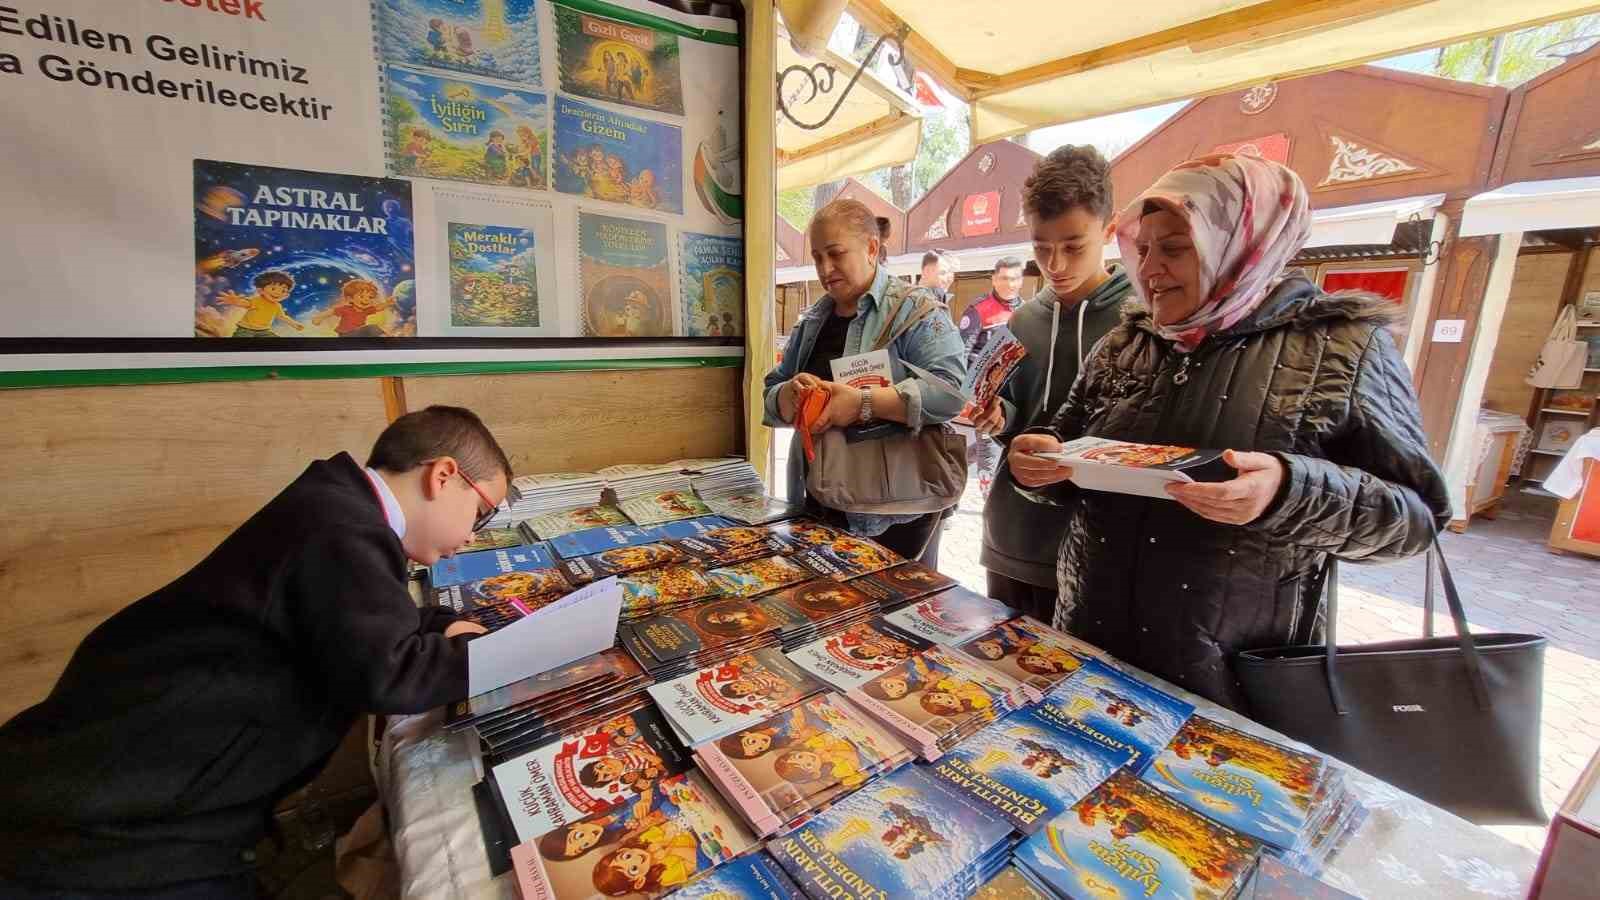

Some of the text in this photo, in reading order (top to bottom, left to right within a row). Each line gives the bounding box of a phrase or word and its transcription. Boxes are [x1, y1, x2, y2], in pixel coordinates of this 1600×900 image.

[0, 6, 309, 85] Edilen Gelirimiz
[38, 53, 334, 121] Gönderilecektir
[252, 184, 365, 212] ASTRAL
[226, 207, 388, 235] TAPINAKLAR
[949, 756, 977, 775] SIR
[935, 764, 1039, 825] BULUTLARIN
